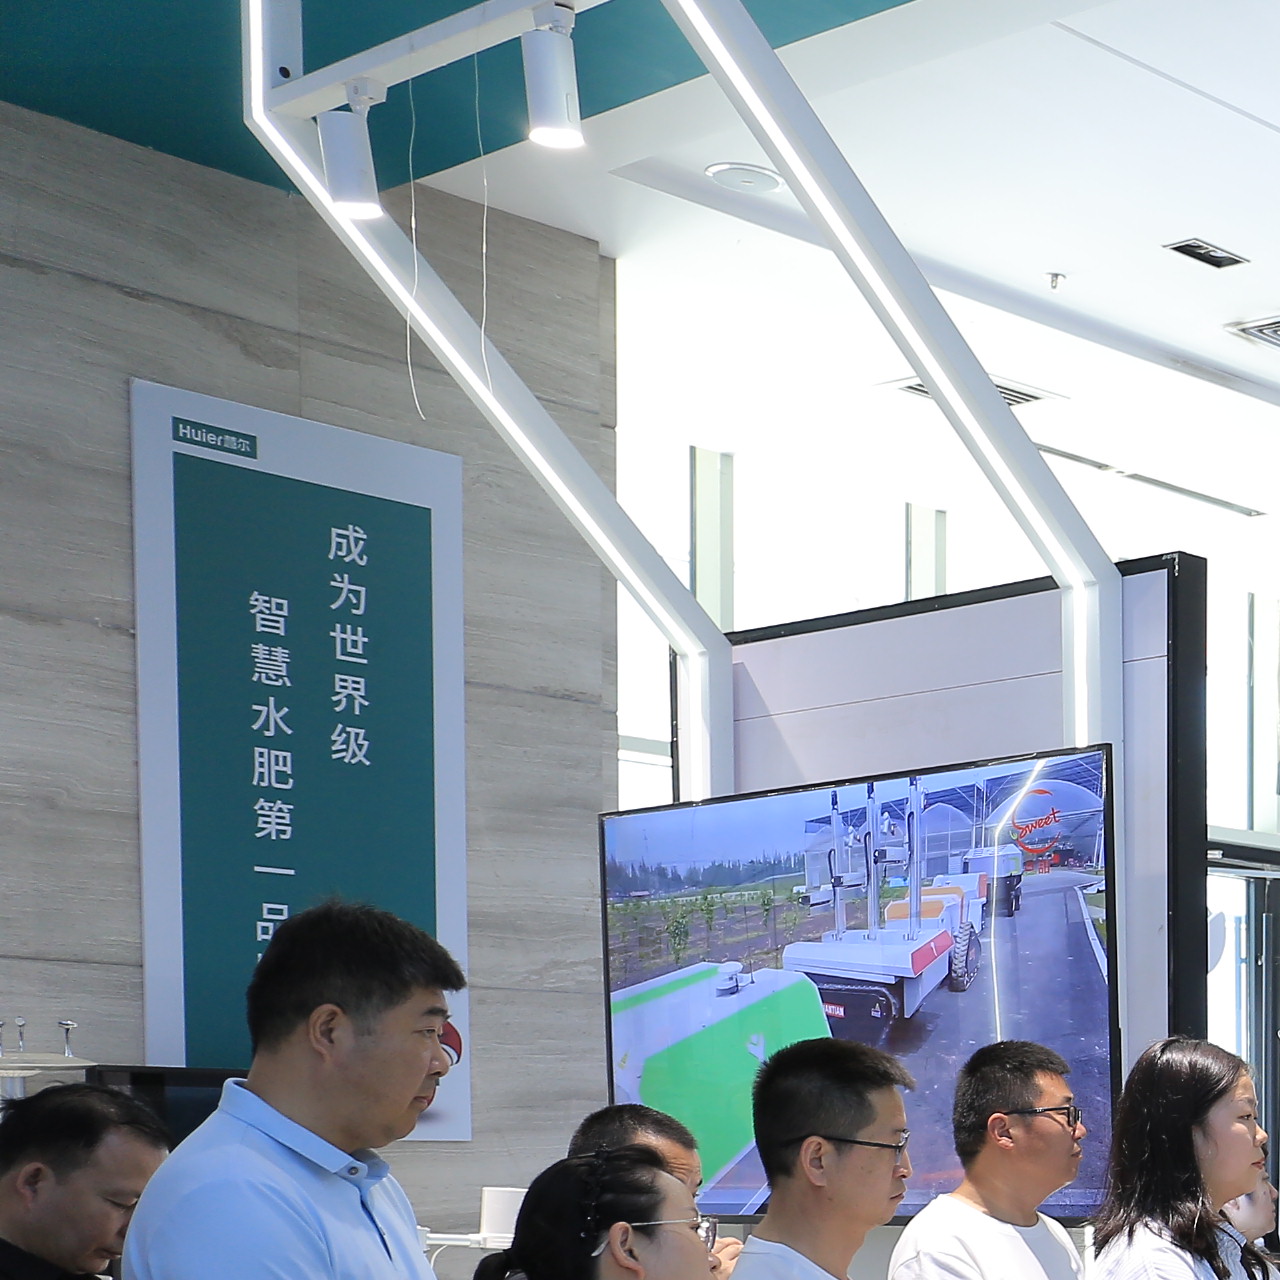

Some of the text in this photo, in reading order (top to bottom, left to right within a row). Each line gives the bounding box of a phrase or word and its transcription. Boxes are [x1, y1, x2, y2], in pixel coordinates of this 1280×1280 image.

[328, 525, 371, 767] 成为世界级
[248, 591, 296, 962] 智慧水肥第一品
[1018, 807, 1061, 839] Sweet
